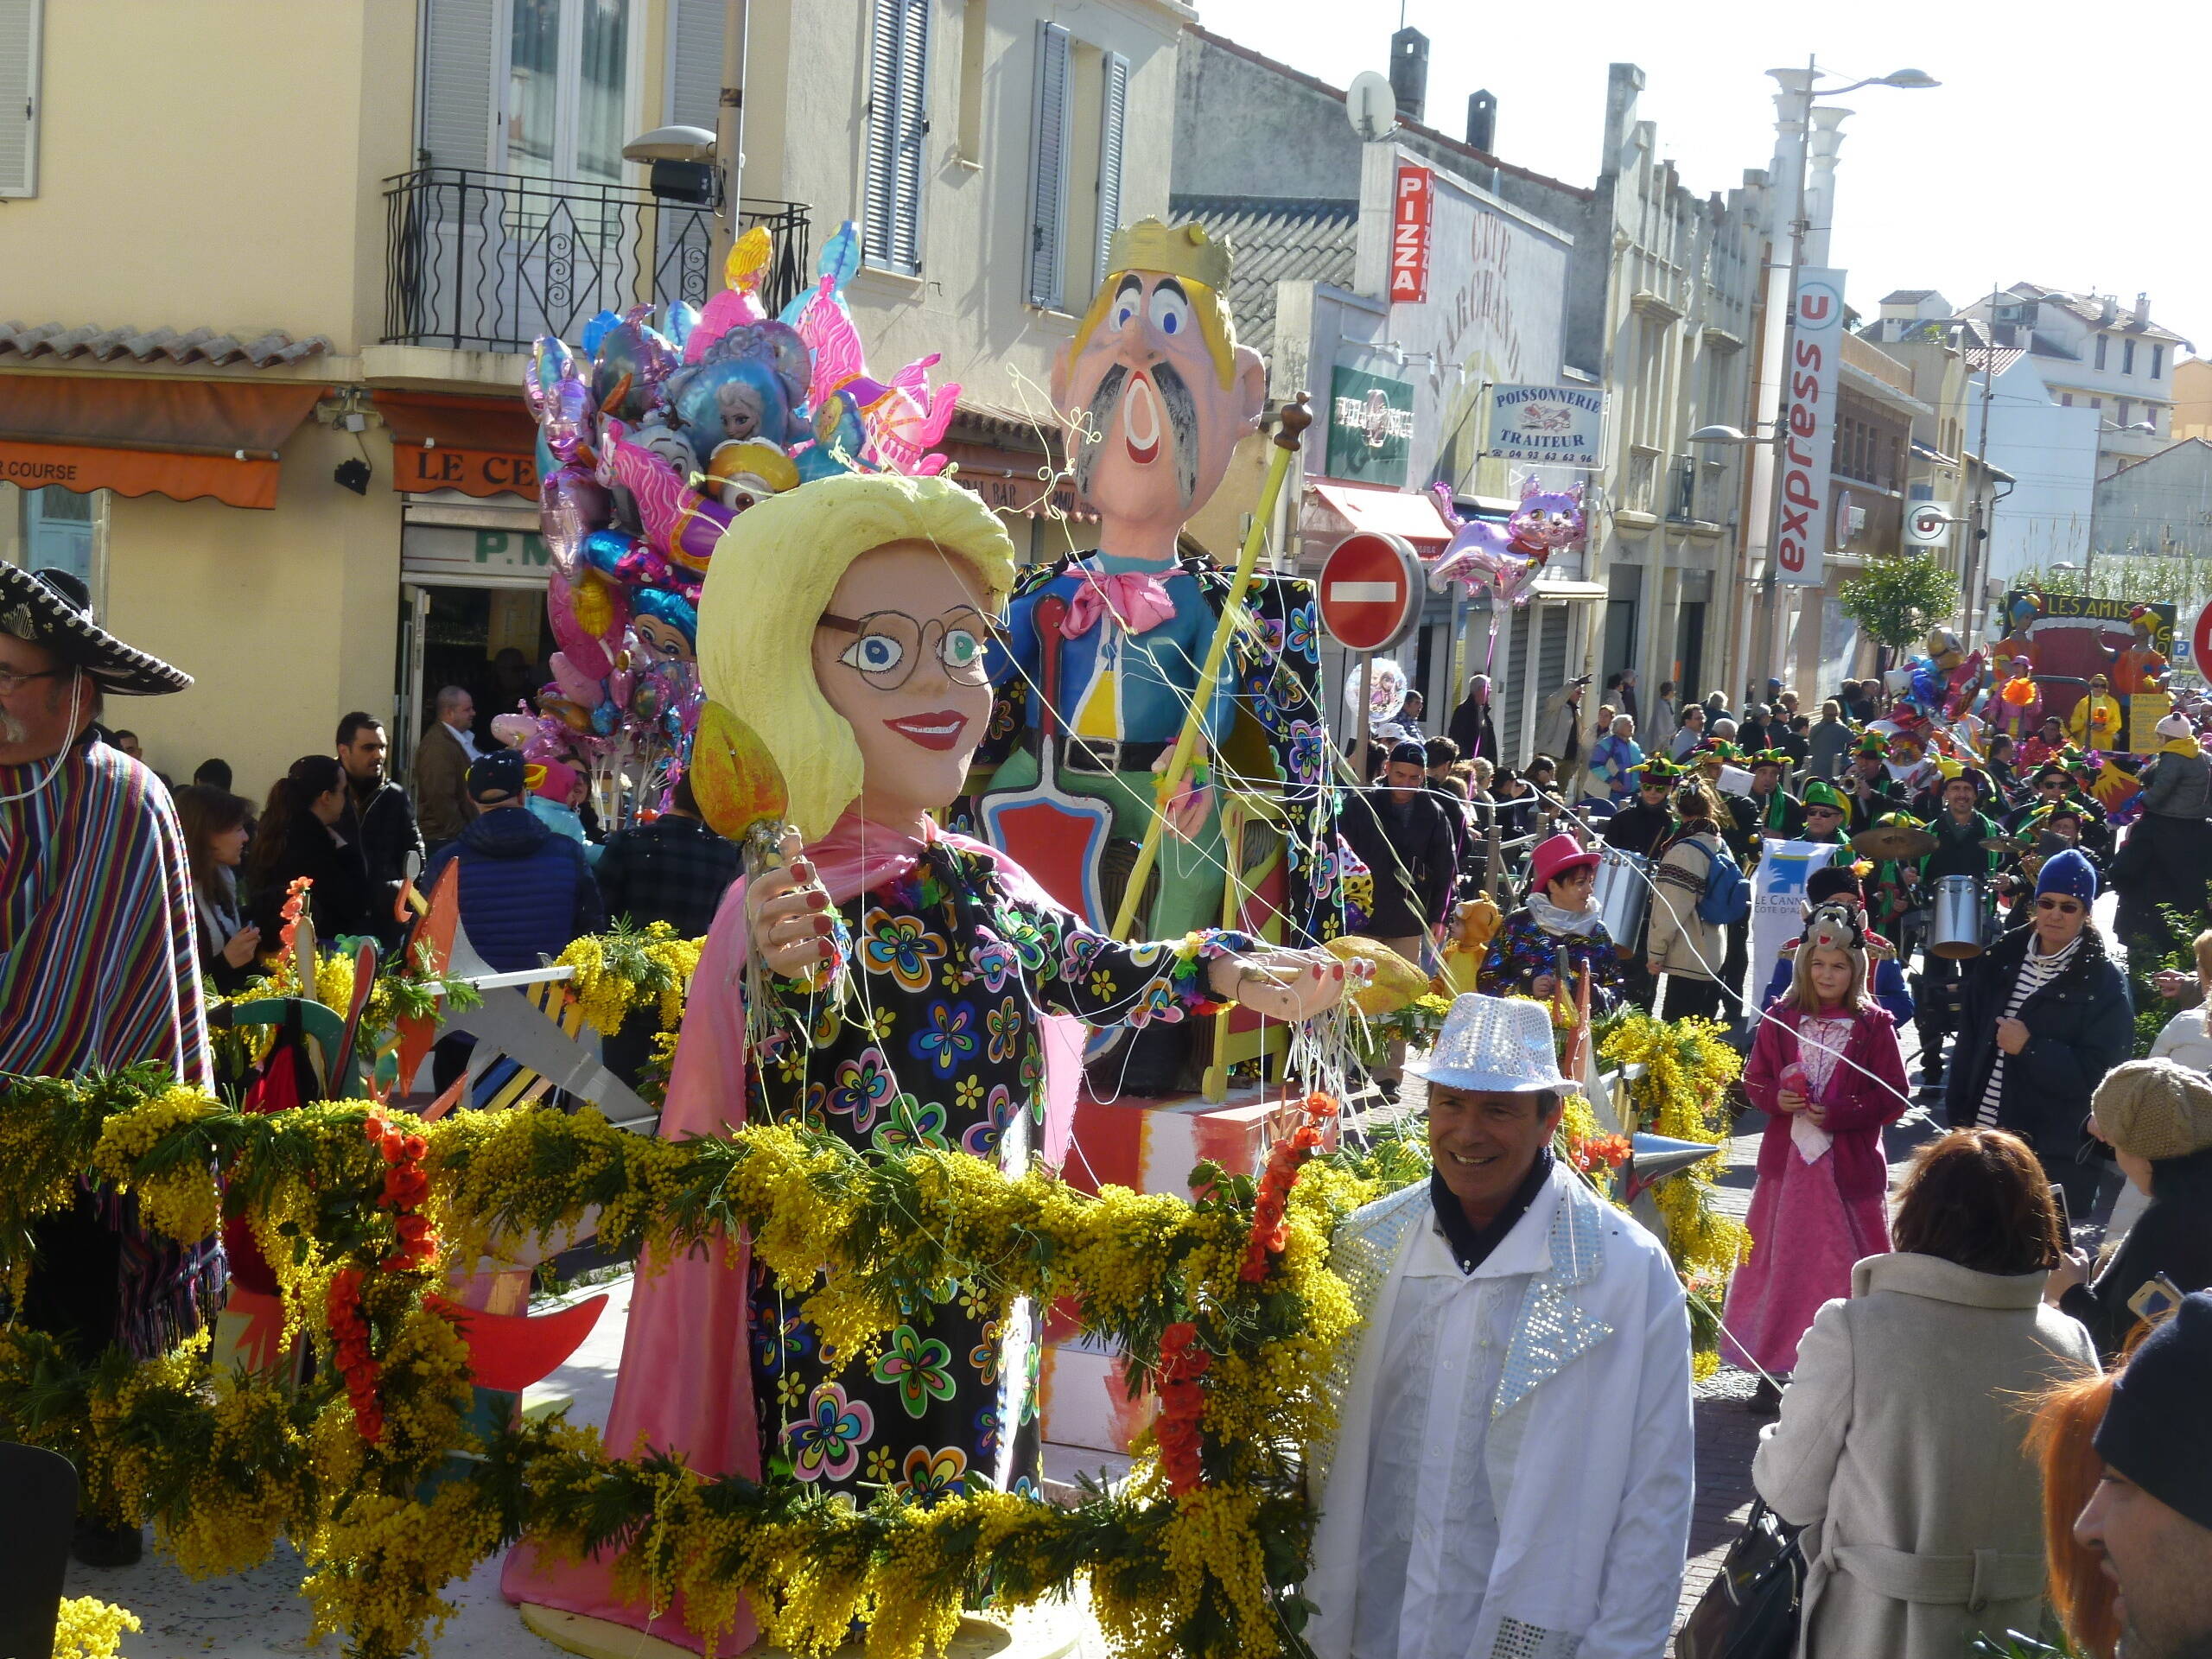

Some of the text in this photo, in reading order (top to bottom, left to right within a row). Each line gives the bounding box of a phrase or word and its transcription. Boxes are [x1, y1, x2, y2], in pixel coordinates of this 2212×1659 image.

[1392, 177, 1422, 290] PIZZA
[1801, 295, 1829, 321] U
[1496, 388, 1601, 414] POISSONNERIE
[1500, 429, 1585, 448] TRAITEUR
[1528, 451, 1539, 460] 93
[1545, 452, 1557, 461] 63
[1562, 454, 1574, 462] 63
[1778, 339, 1822, 574] express
[9, 461, 77, 480] COURSE
[417, 452, 540, 486] LE CE
[994, 482, 1017, 506] BAR
[1052, 491, 1075, 512] PMU
[2048, 597, 2132, 618] LES AMIS
[2177, 643, 2185, 654] P
[1755, 894, 1807, 906] LE CANN
